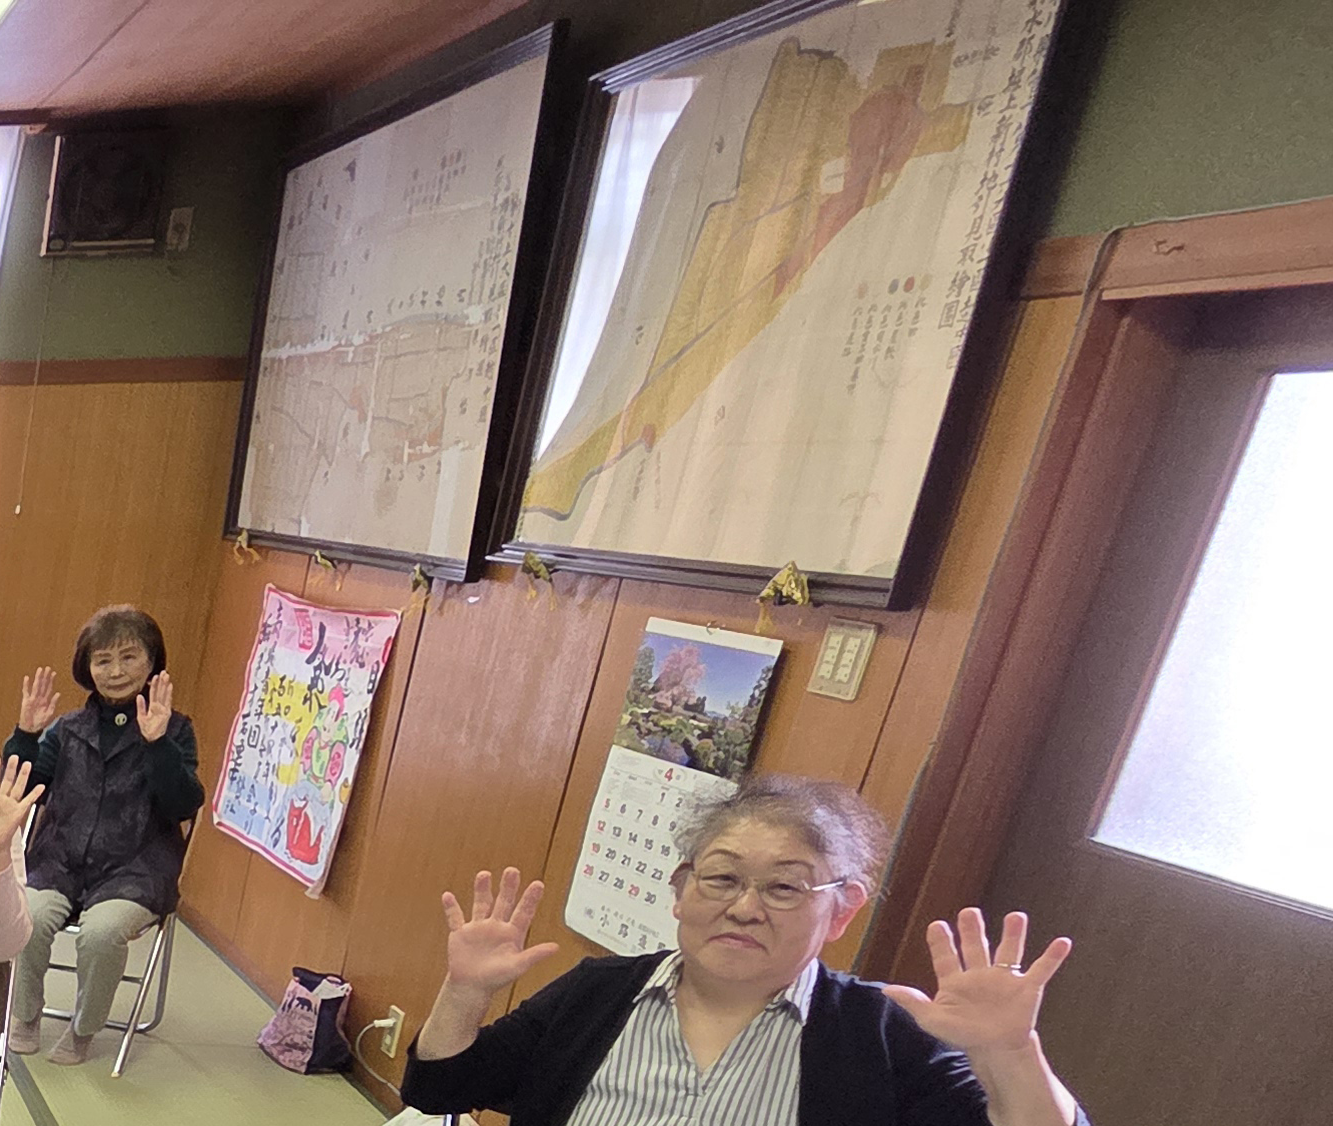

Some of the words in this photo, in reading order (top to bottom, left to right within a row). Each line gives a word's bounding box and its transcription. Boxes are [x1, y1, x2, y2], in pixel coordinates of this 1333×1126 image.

[664, 768, 674, 781] 4
[604, 798, 611, 809] 5
[620, 803, 627, 814] 6
[636, 809, 643, 820] 7
[652, 814, 659, 826] 8
[669, 821, 676, 831] 9
[660, 792, 666, 803] 1
[675, 797, 683, 808] 2
[597, 820, 606, 832] 12
[613, 826, 622, 837] 13
[628, 832, 638, 844] 14
[644, 838, 654, 850] 15
[661, 844, 670, 857] 16
[605, 848, 617, 860] 20
[621, 854, 631, 866] 21
[635, 861, 647, 874] 22
[651, 868, 663, 880] 23
[583, 864, 594, 876] 26
[598, 870, 610, 882] 27
[613, 877, 625, 889] 28
[628, 884, 640, 897] 29
[644, 891, 656, 904] 30
